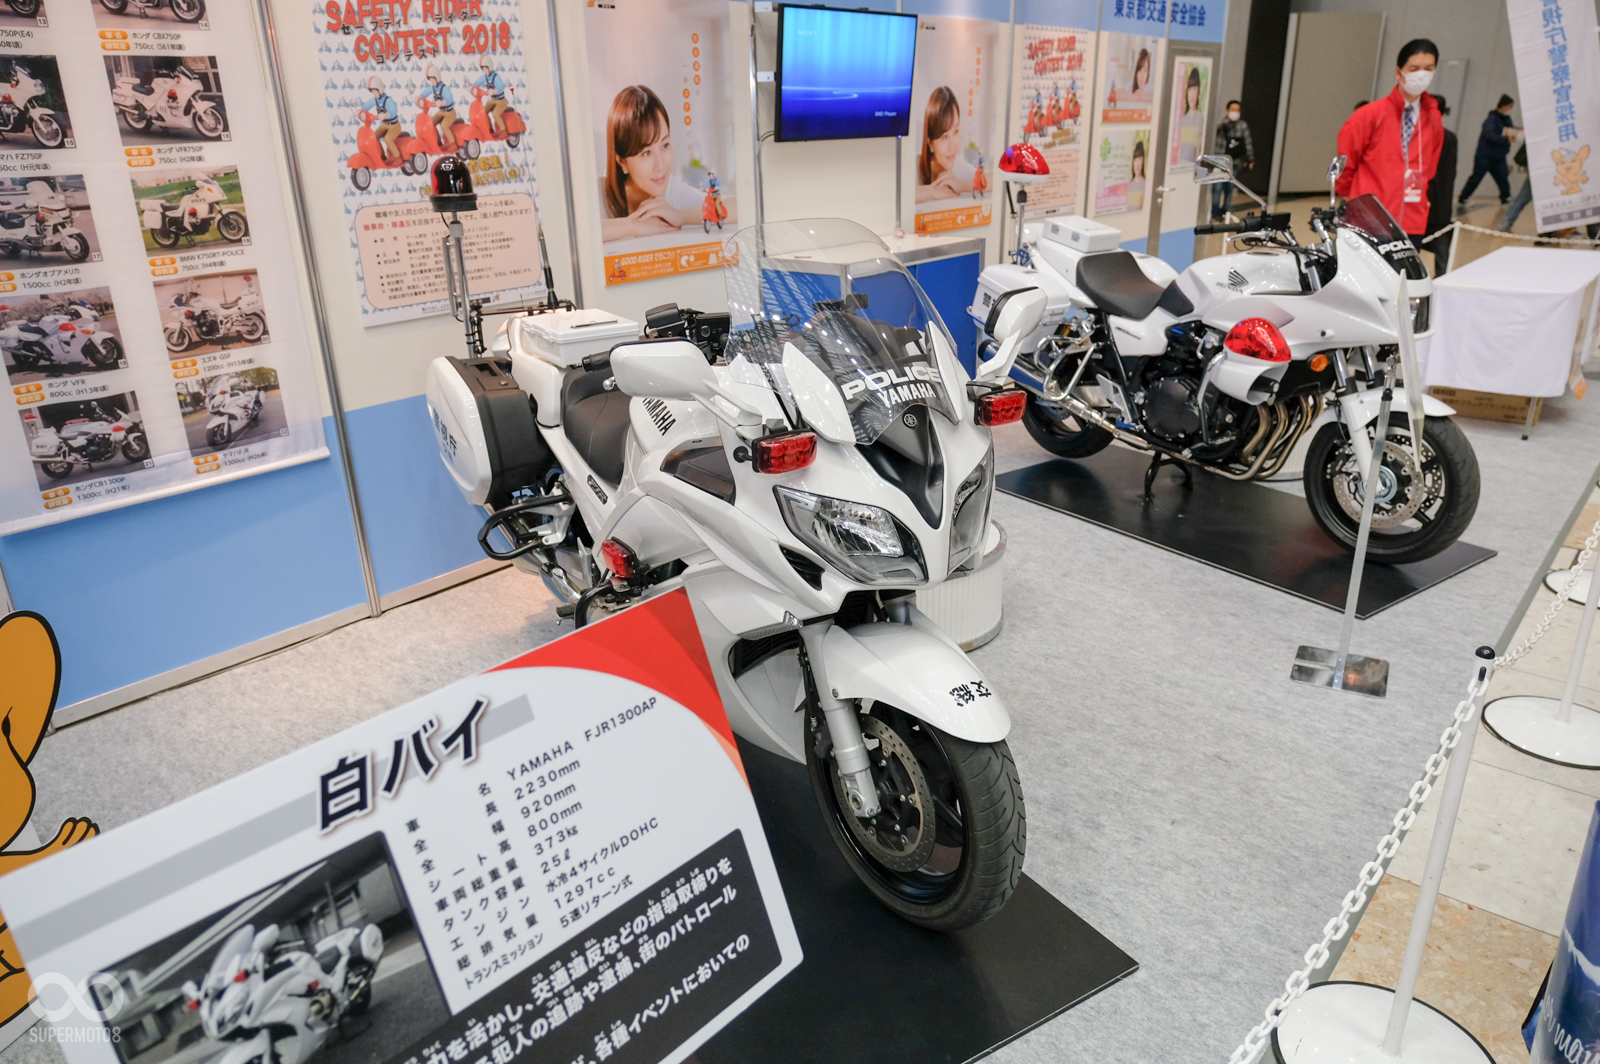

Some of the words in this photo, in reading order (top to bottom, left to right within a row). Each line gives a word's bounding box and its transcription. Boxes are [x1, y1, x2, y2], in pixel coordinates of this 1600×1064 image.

[326, 0, 411, 31] SAFETY
[422, 0, 483, 23] RIDER
[341, 18, 402, 35] セーフティ
[354, 27, 451, 62] CONTEST
[462, 21, 511, 54] 2018
[375, 47, 440, 64] コンテスト
[182, 264, 200, 272] 750cc
[22, 280, 52, 289] 1500cc
[203, 364, 225, 373] 1200cc
[841, 366, 942, 401] POLICE
[50, 390, 73, 398] 800cc
[877, 382, 936, 408] YAMAHA
[642, 397, 677, 437] AMAHA
[224, 458, 246, 467] 1300cc
[77, 490, 103, 500] 1300cc
[507, 741, 573, 781] YAMAHA
[584, 697, 658, 742] FJR1300AP
[320, 698, 486, 832] 白バイ
[514, 758, 581, 800] 2230mm
[520, 783, 577, 818] 920mm
[527, 801, 583, 837] 800mm
[464, 933, 544, 990] トランスミッション
[560, 874, 633, 929] 5速リターン式
